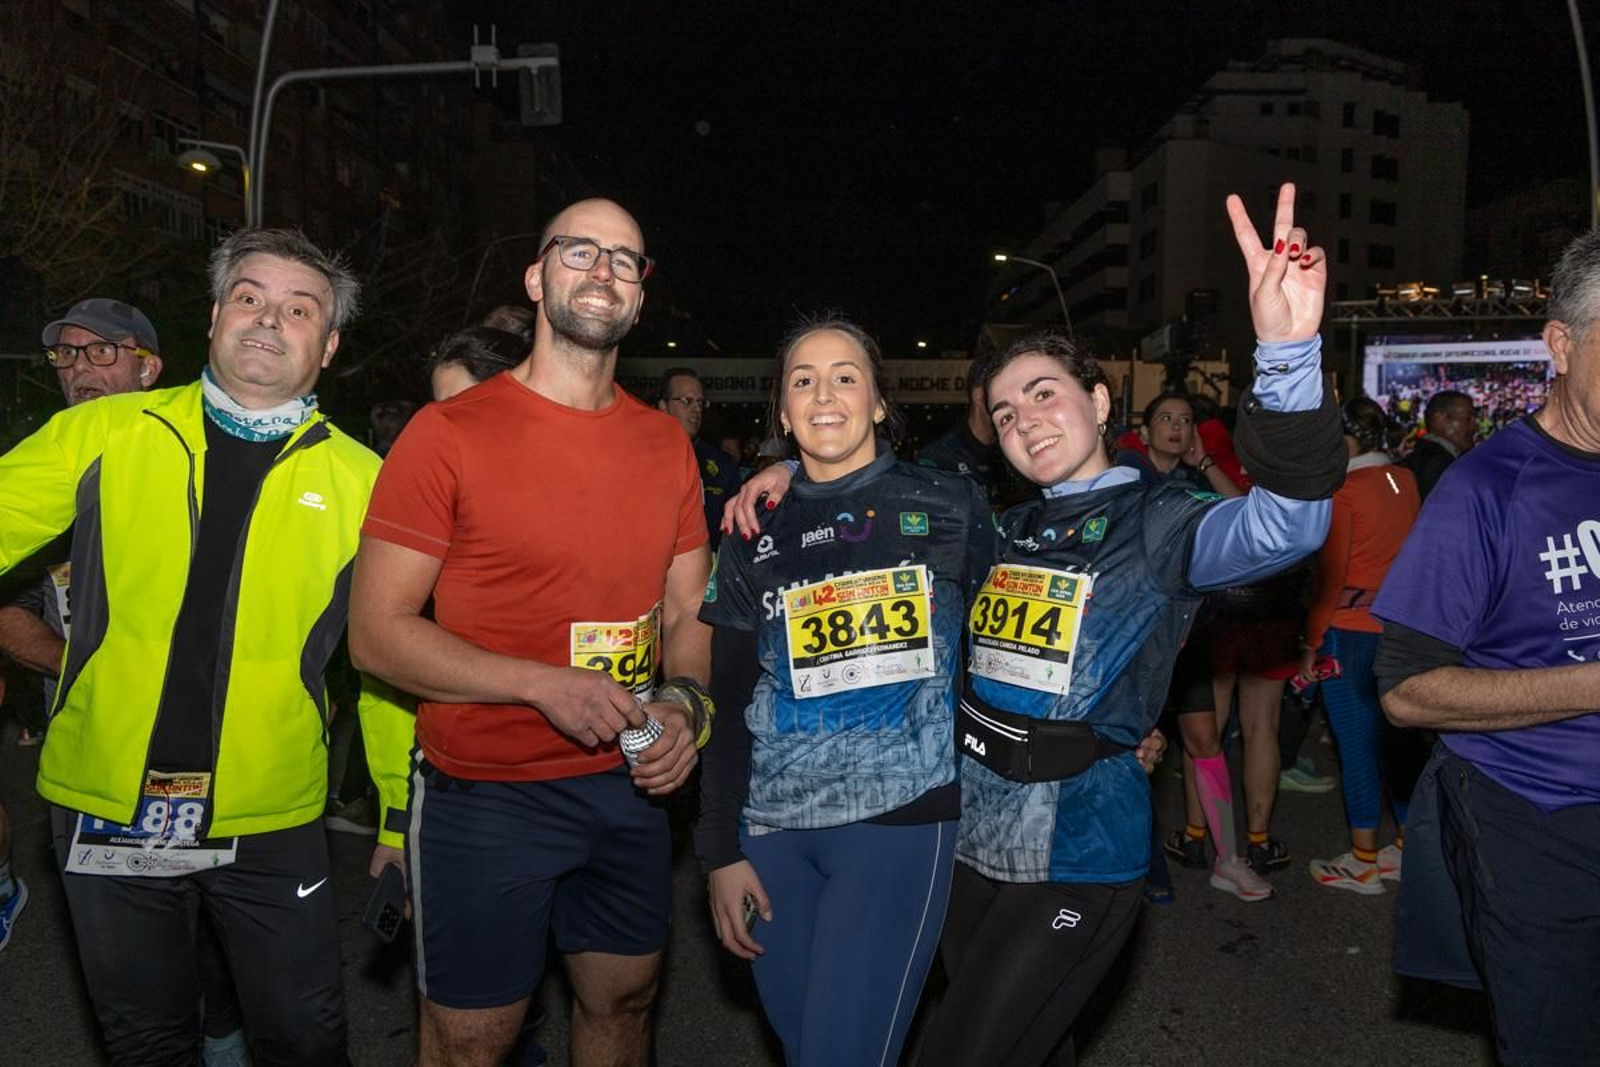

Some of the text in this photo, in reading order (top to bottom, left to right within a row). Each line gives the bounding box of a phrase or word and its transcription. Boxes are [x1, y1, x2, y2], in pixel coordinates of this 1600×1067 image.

[700, 375, 756, 391] RBANA
[992, 571, 1009, 589] 42
[812, 584, 836, 606] 42
[801, 600, 919, 654] 3843
[974, 595, 1062, 646] 3914
[1559, 618, 1579, 631] de
[964, 733, 986, 756] FILA
